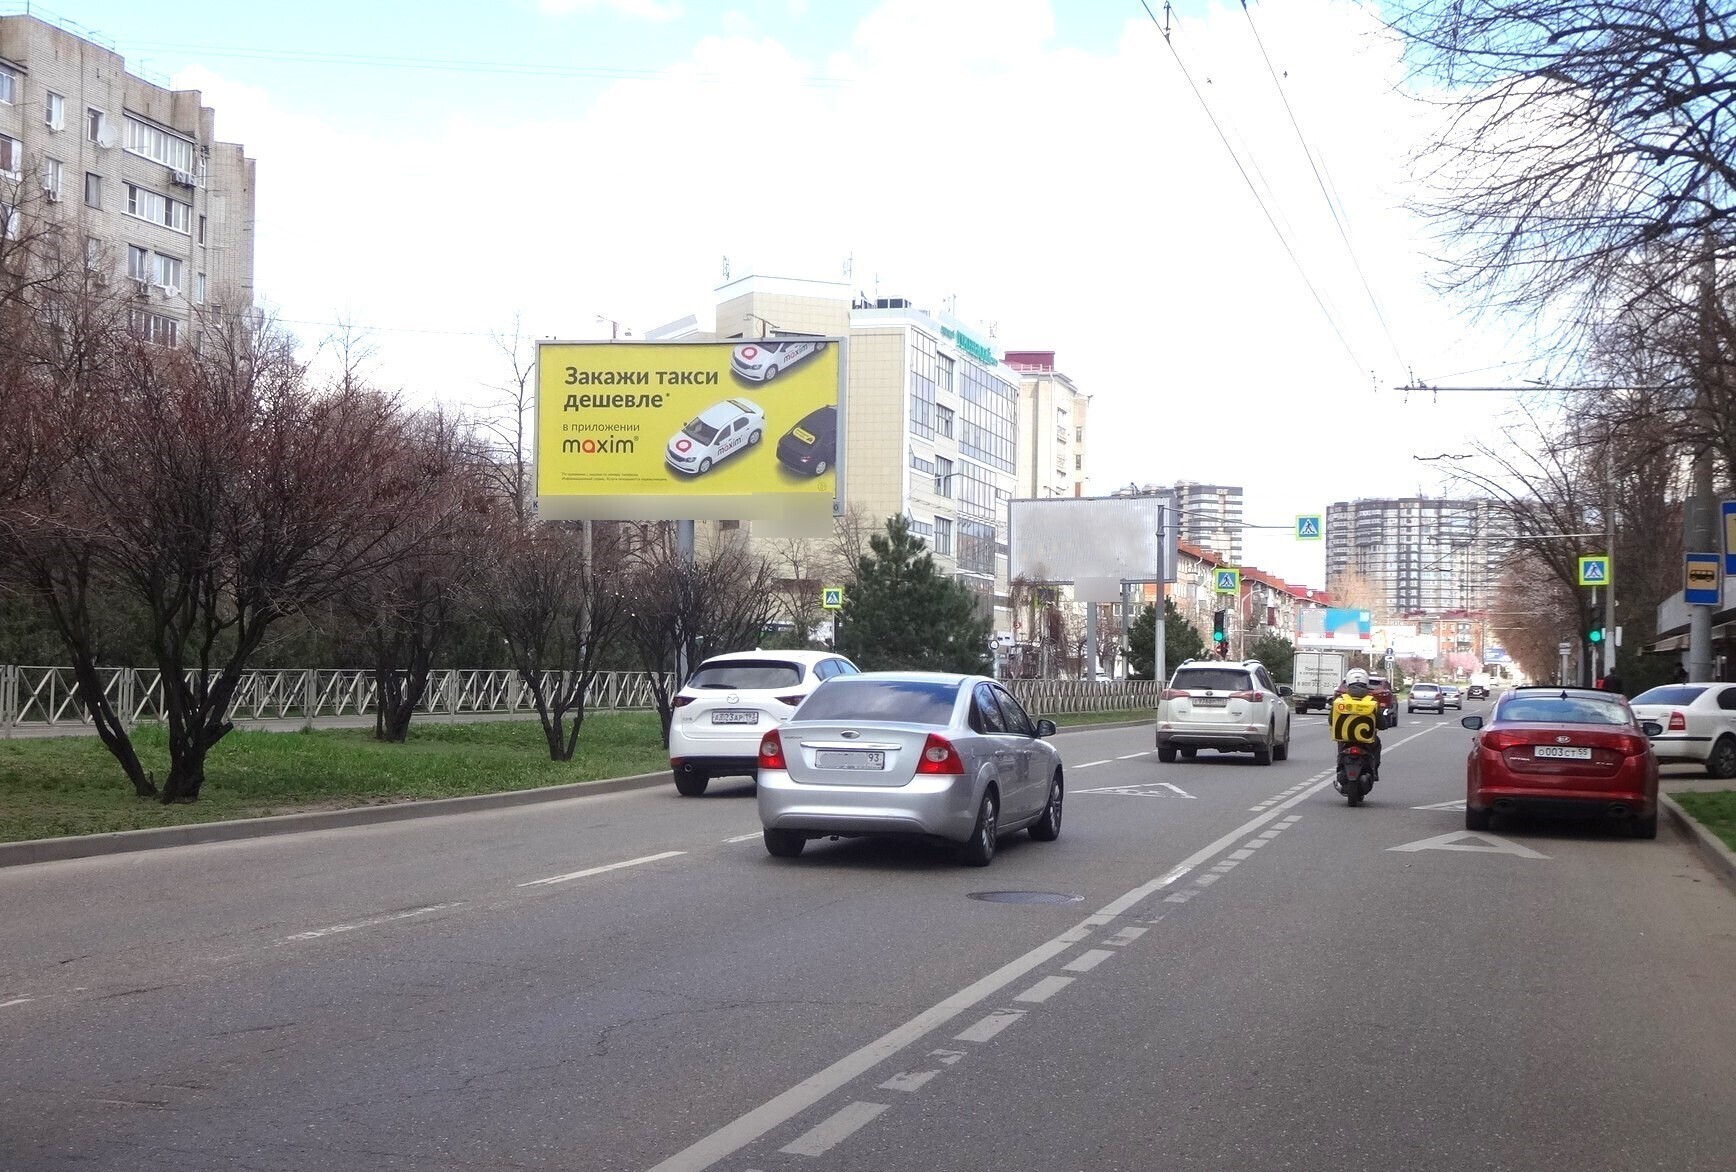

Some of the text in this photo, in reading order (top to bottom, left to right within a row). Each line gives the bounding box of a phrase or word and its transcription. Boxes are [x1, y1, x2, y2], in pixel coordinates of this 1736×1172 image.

[564, 366, 719, 386] Закажи такси
[562, 423, 641, 433] в приложении
[1578, 748, 1588, 756] 55
[868, 753, 880, 763] 93
